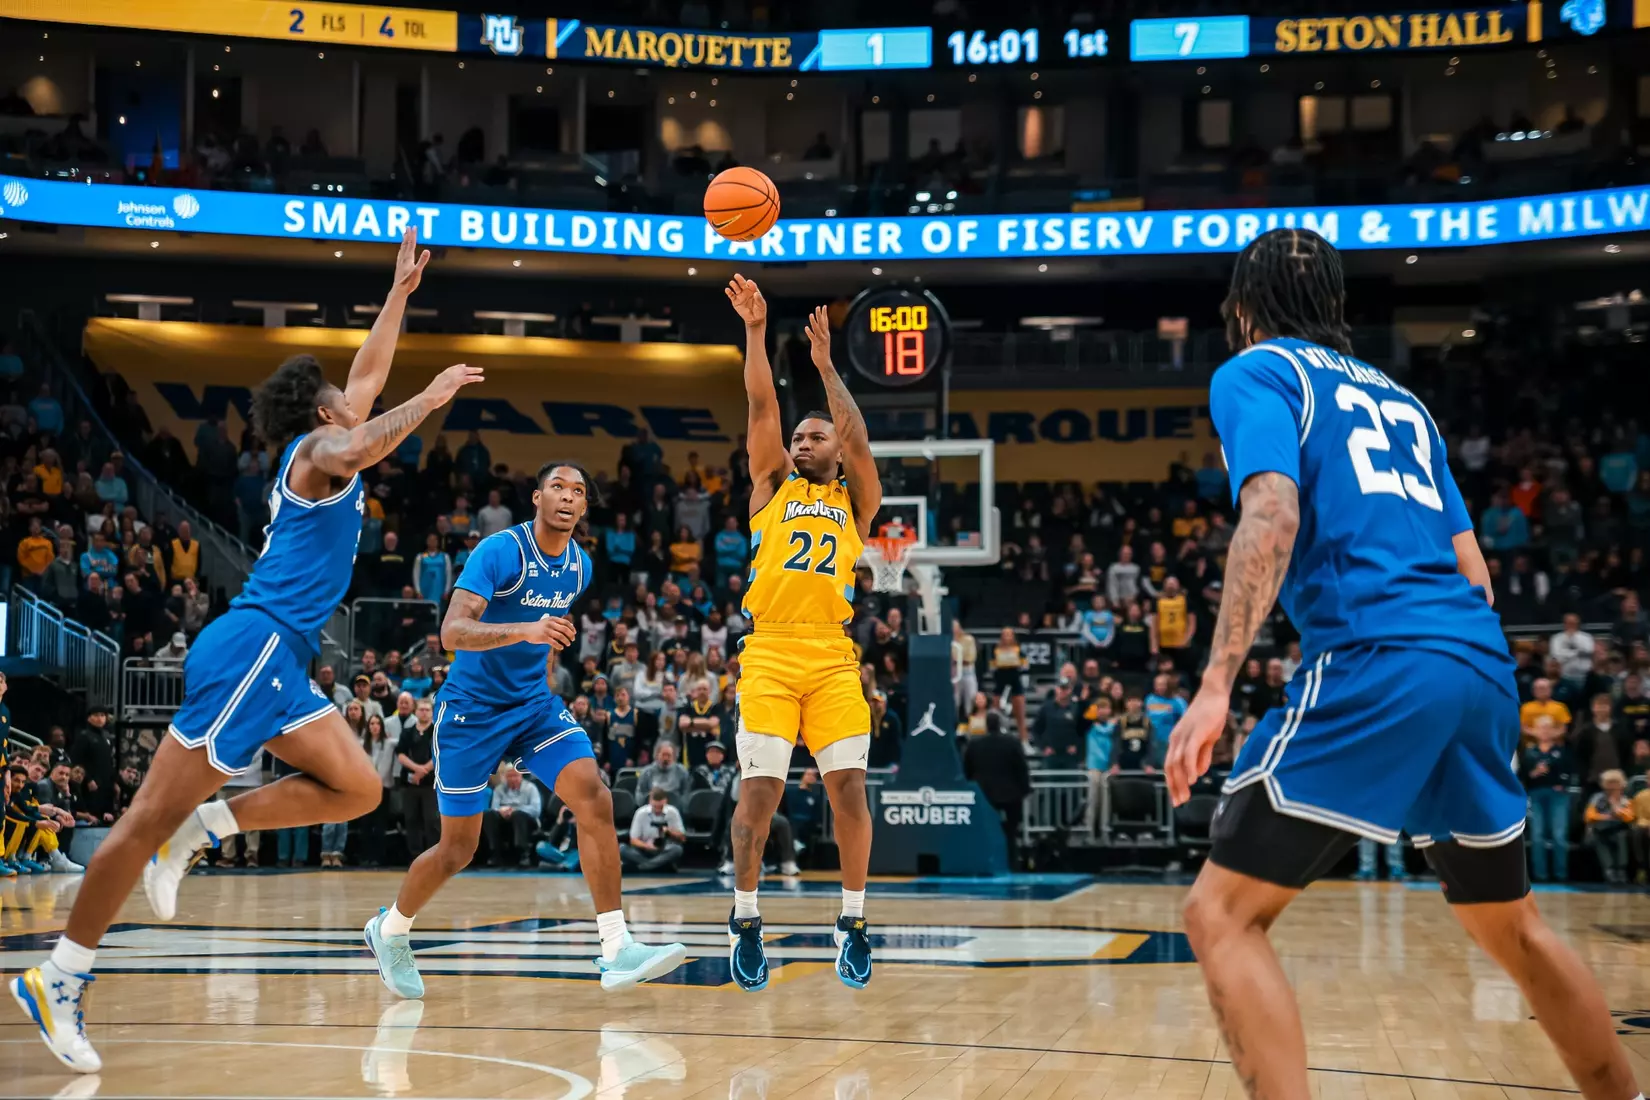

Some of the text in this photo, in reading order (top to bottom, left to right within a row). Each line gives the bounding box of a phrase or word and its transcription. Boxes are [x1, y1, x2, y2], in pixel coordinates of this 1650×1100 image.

[289, 9, 427, 38] 2 FLS 4 TOL
[1174, 22, 1199, 56] 7
[1275, 10, 1513, 52] SETON HALL
[585, 26, 792, 67] MARQUETTE
[867, 33, 884, 66] 1
[948, 28, 1108, 64] 16:01 1st
[118, 201, 166, 214] Johnson
[125, 213, 175, 228] Controls
[283, 200, 440, 239] SMART
[460, 209, 684, 253] BUILDING
[921, 220, 979, 253] OF
[998, 215, 1153, 251] FISERV
[1358, 210, 1392, 243] &
[1409, 205, 1498, 242] THE
[1518, 192, 1650, 236] MILW
[870, 305, 928, 332] 16:00
[884, 331, 925, 376] 18
[441, 397, 732, 443] ARE
[1335, 383, 1443, 512] 23
[783, 530, 838, 577] 22
[520, 589, 576, 609] Seton Hall
[883, 805, 971, 825] GRUBER
